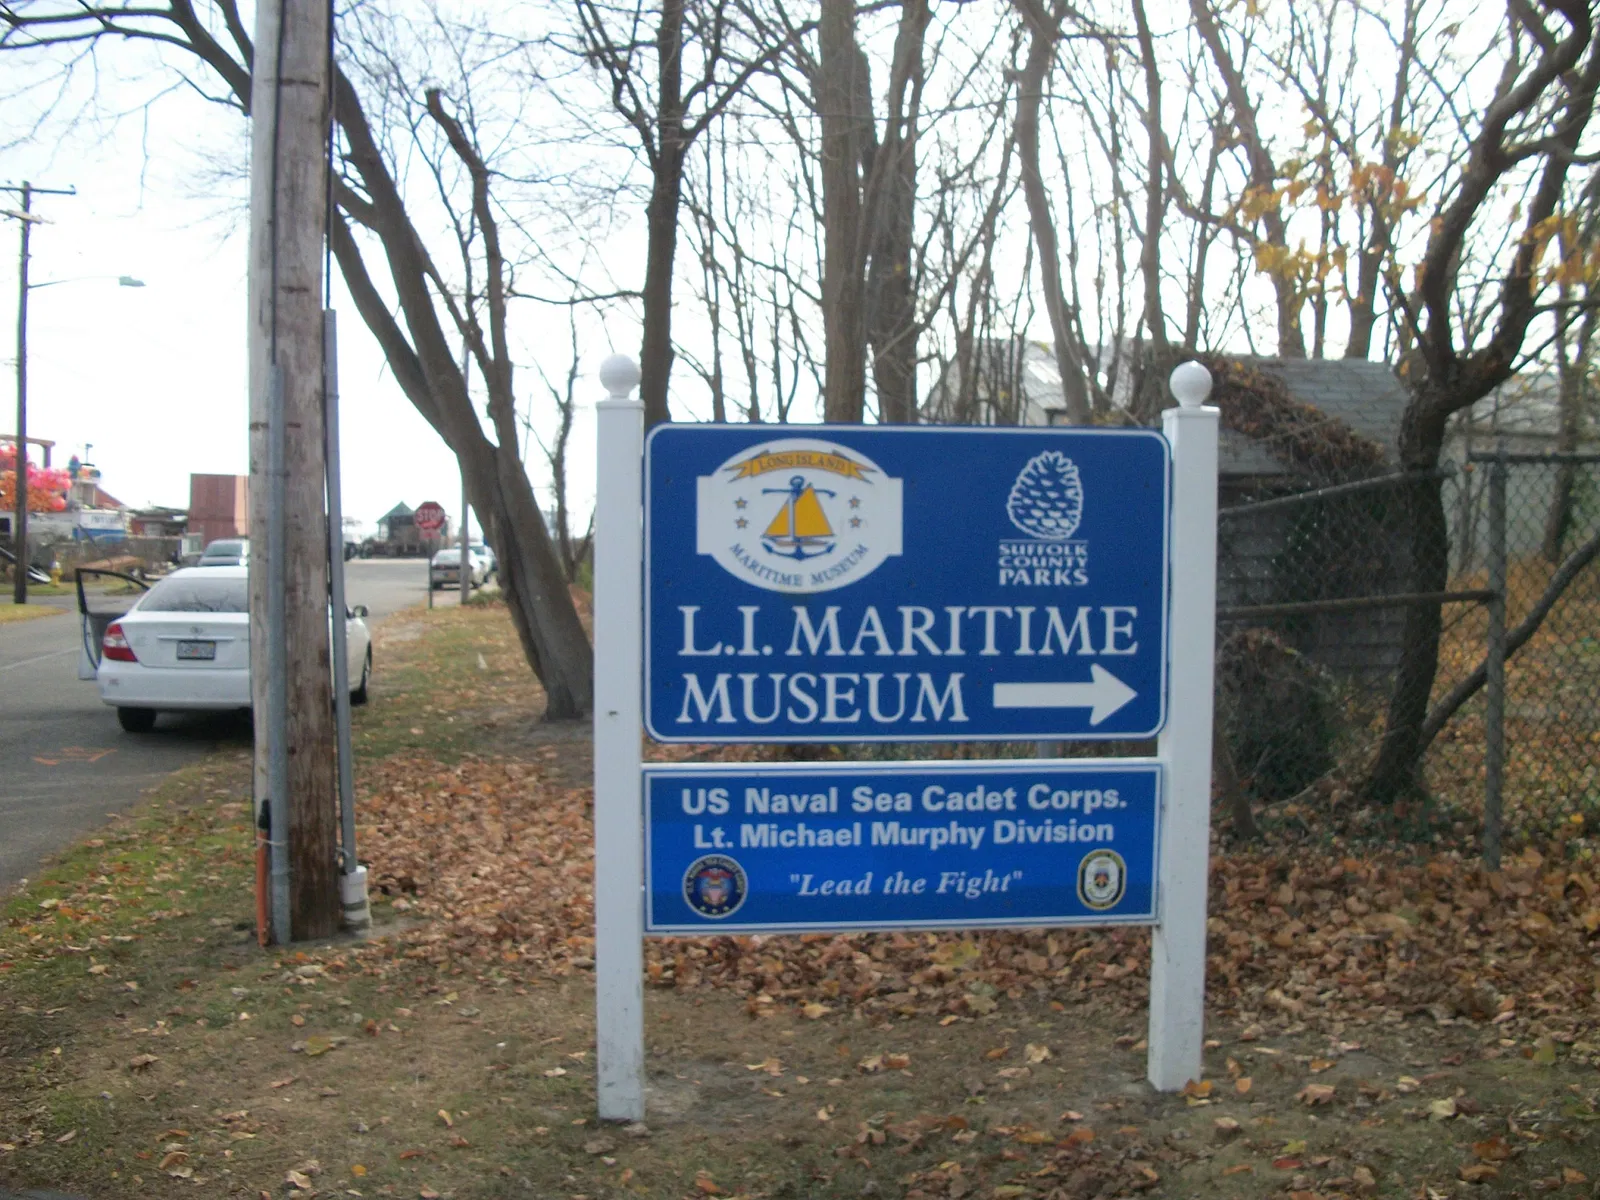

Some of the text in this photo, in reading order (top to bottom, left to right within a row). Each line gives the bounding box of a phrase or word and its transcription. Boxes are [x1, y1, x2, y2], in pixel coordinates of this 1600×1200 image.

[760, 454, 845, 470] LONG ISLAND
[415, 509, 445, 522] STOP
[998, 556, 1088, 568] COUNTY
[999, 543, 1087, 556] SUFFOLK
[729, 543, 869, 587] MARITIME MUSEUM
[999, 569, 1089, 586] PARKS
[678, 605, 1138, 656] L.I. MARITIME
[676, 672, 969, 724] MUSEUM
[681, 783, 1127, 815] US Naval Sea Cadet Corps.
[694, 818, 1114, 851] Lt. Michael Murphy Division
[790, 869, 1023, 899] "Lead the Fight"
